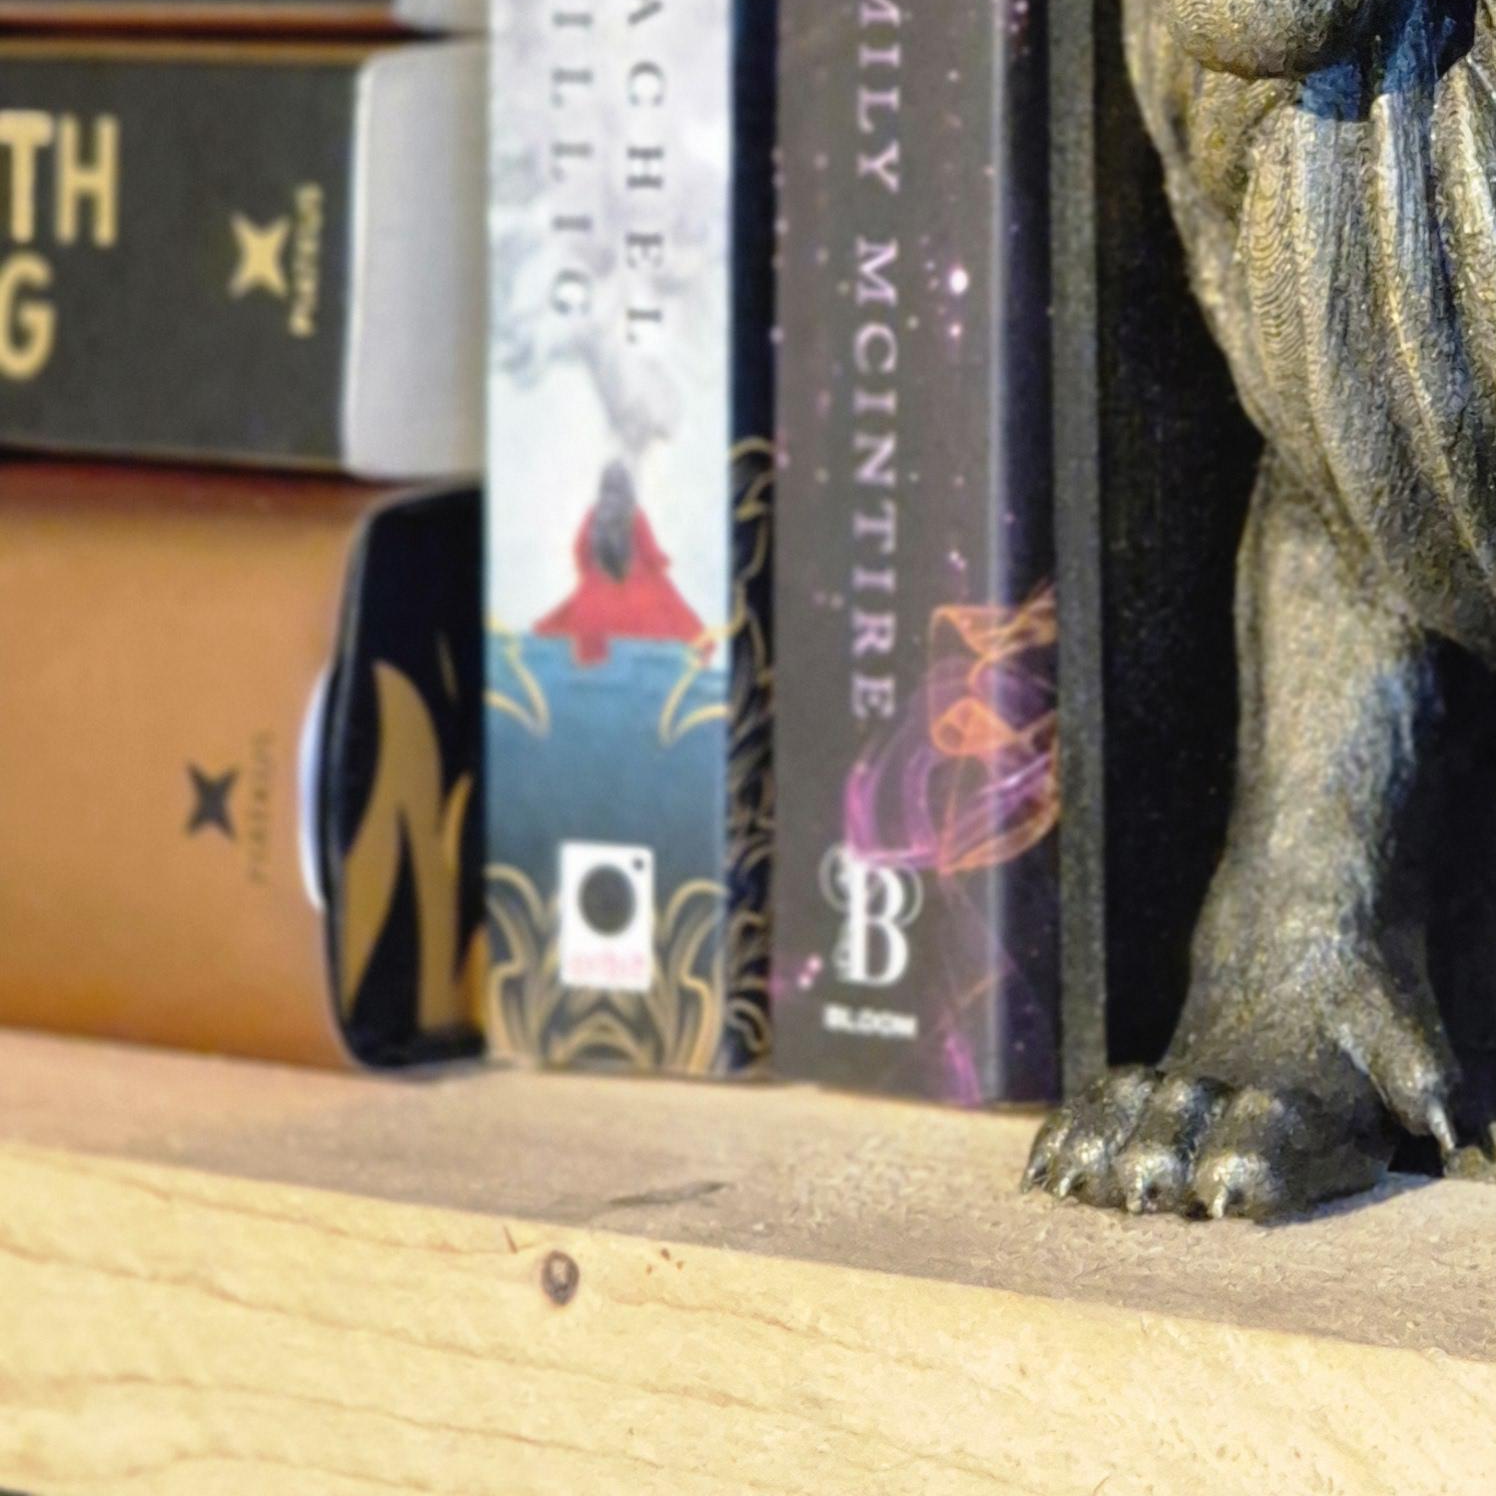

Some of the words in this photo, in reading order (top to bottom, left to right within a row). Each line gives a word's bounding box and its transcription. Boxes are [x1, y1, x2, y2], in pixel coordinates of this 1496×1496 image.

[0, 110, 120, 248] TH
[851, 236, 899, 720] MCINTIRE
[822, 1003, 918, 1038] BLOOM
